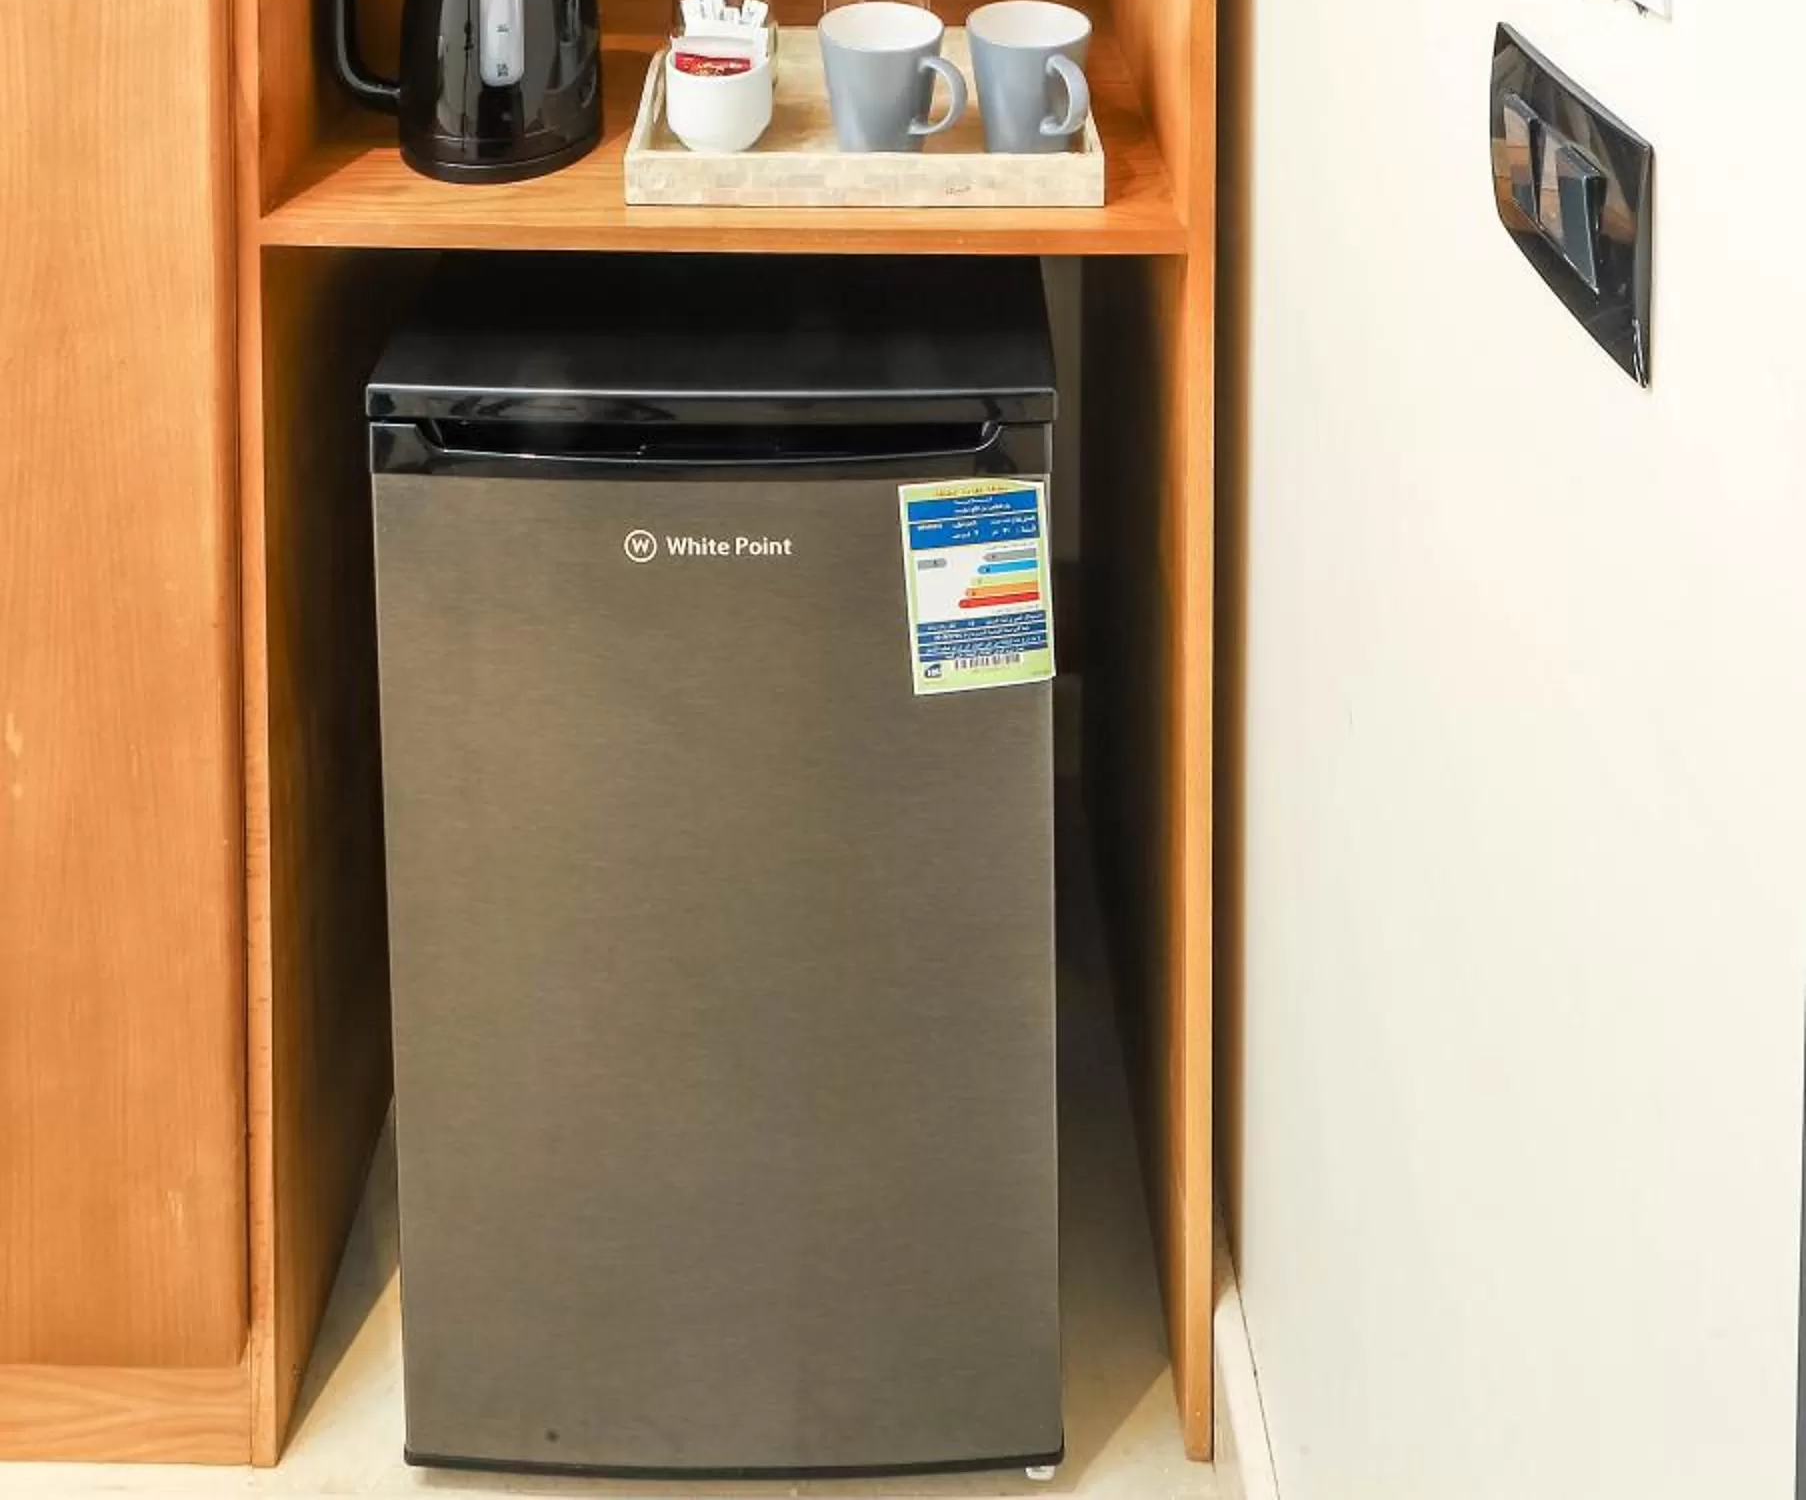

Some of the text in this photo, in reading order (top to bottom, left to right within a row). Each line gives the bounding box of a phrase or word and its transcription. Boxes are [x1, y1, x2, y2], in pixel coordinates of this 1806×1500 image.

[631, 536, 792, 555] W White Point
